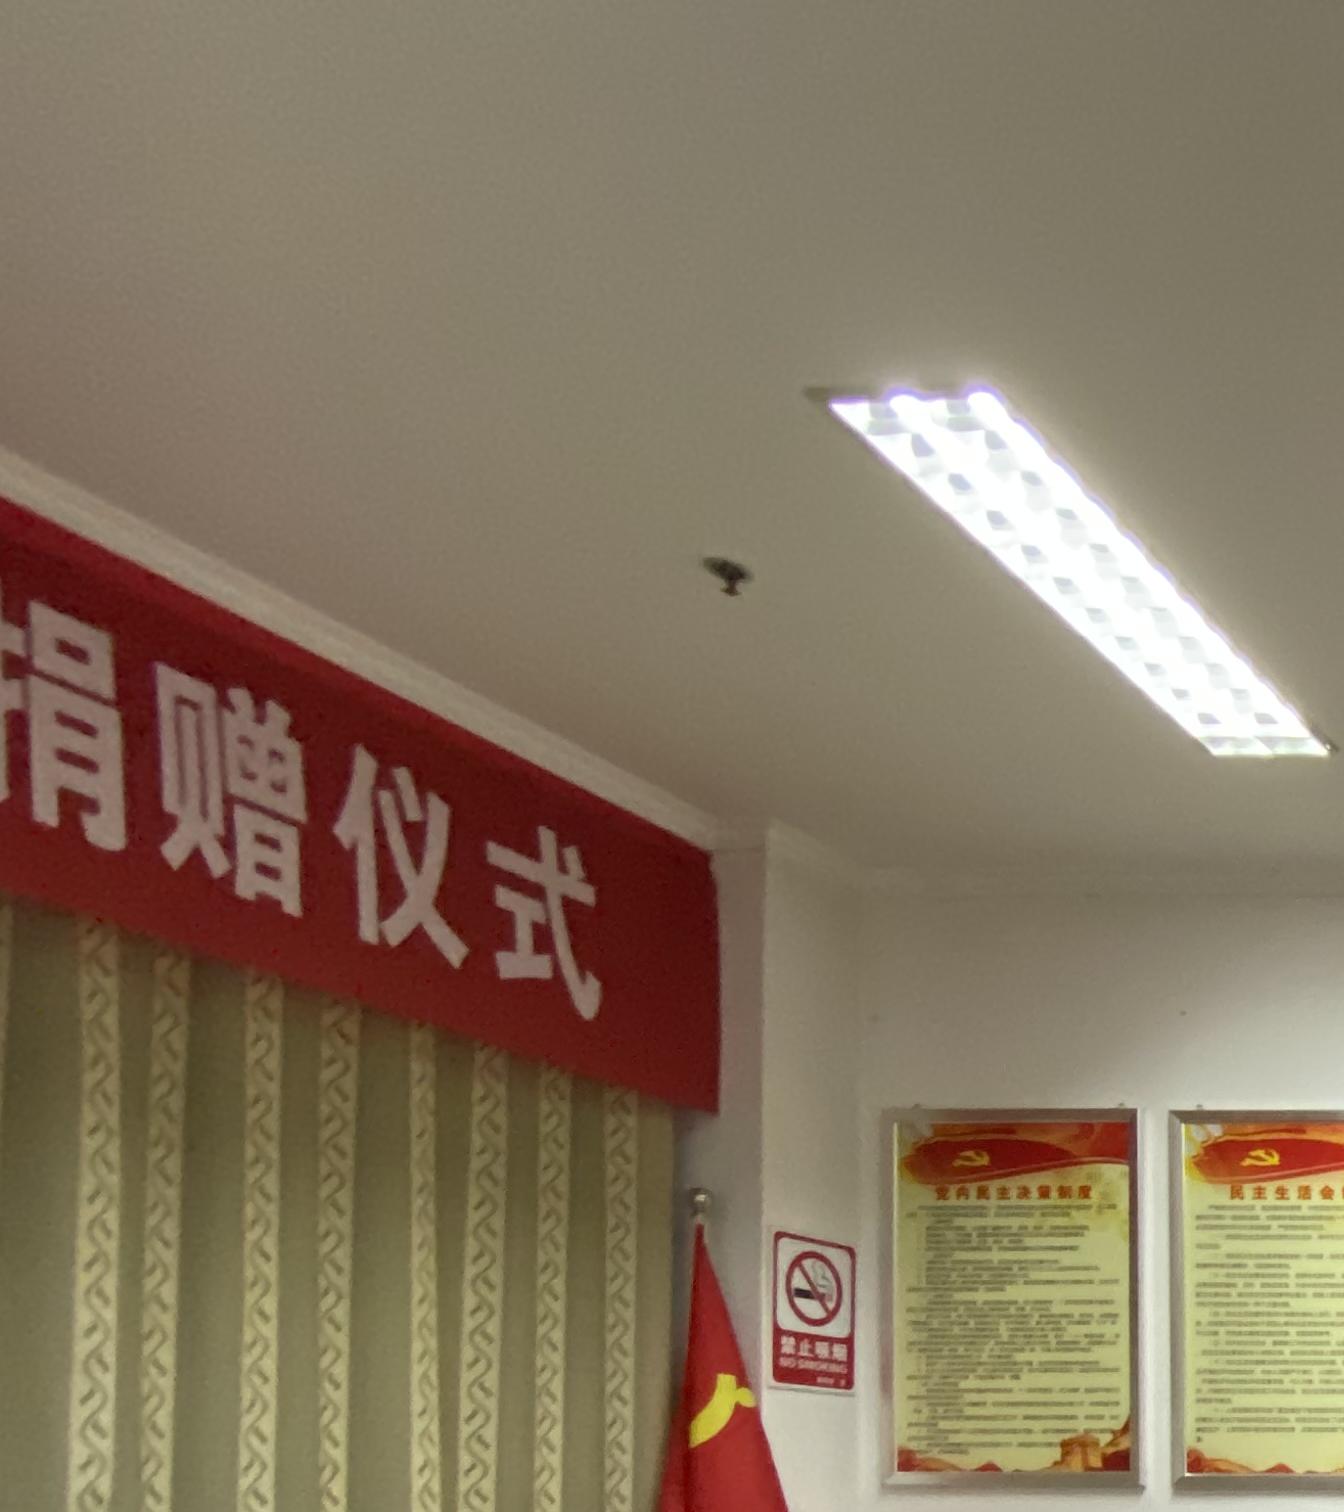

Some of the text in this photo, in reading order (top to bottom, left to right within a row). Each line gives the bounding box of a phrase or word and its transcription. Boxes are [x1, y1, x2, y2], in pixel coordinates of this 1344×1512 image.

[0, 582, 601, 1021] 捐赠仪式
[934, 1184, 1093, 1201] 党内民主决策制度
